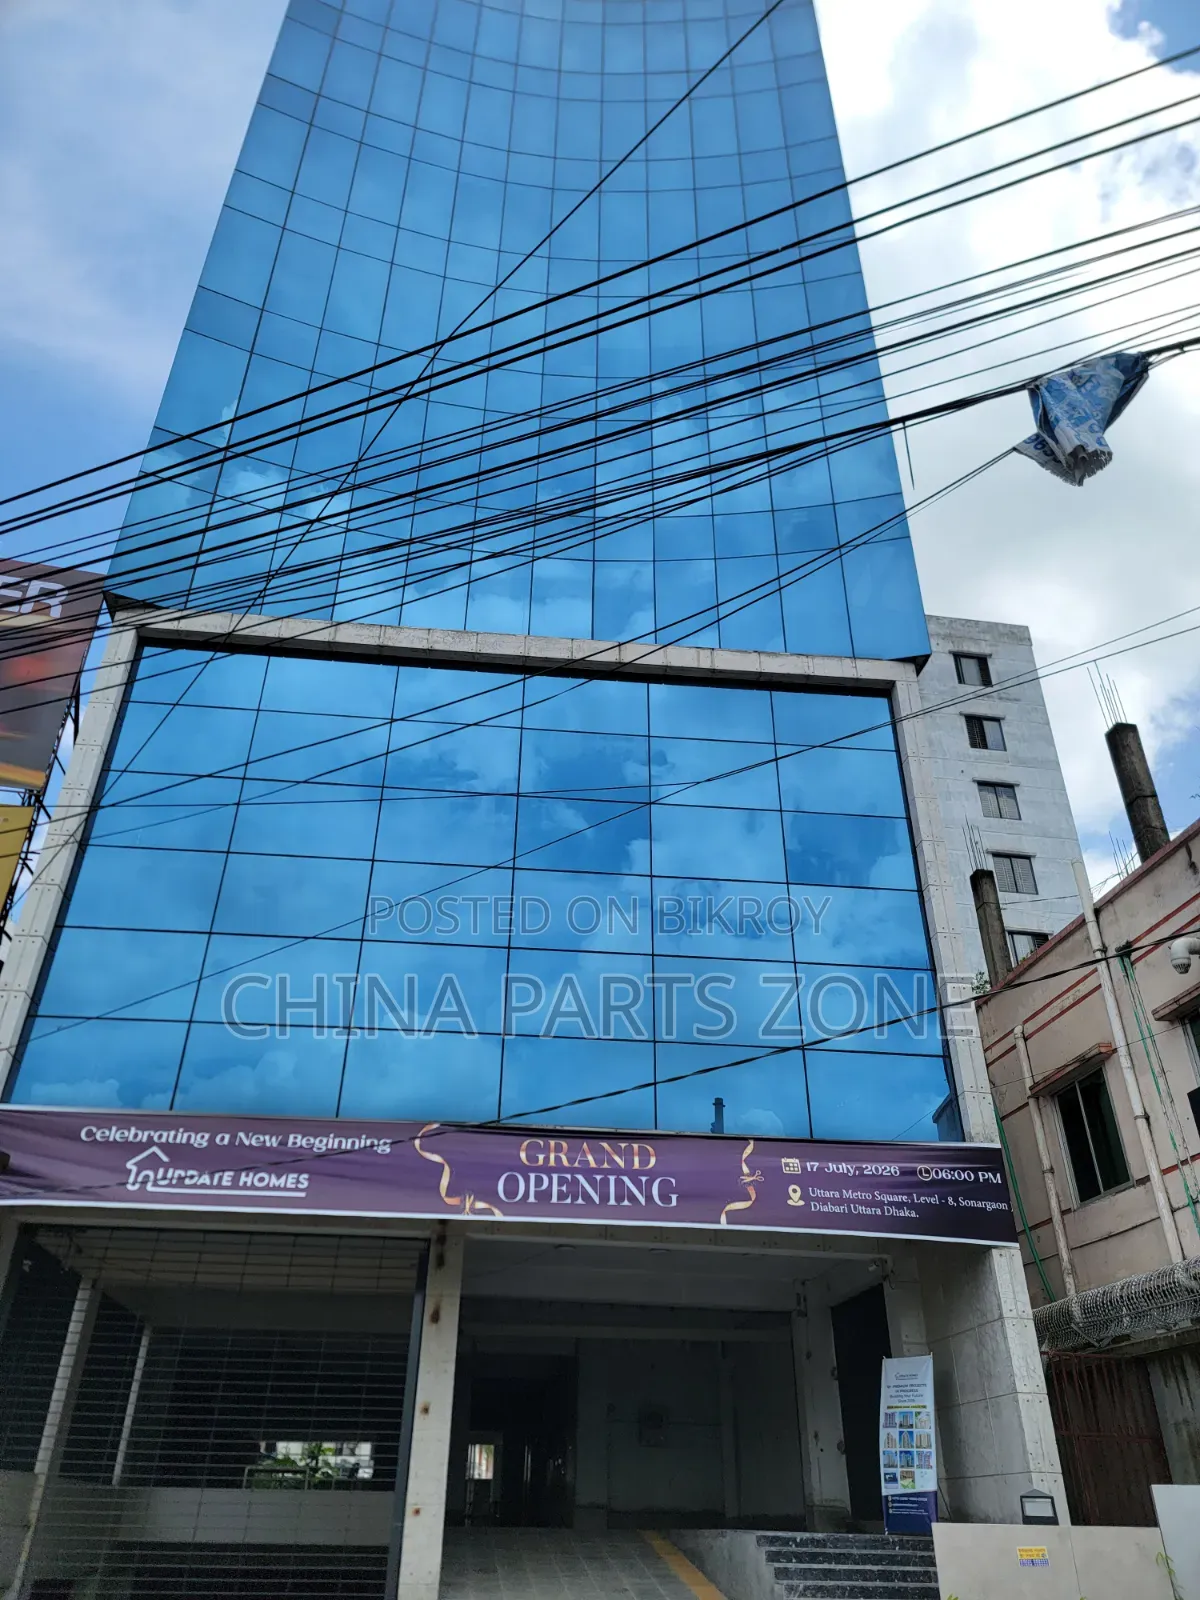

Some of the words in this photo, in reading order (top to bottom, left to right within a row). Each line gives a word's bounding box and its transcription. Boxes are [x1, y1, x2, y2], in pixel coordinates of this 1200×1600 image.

[80, 1125, 211, 1149] Celebrating
[215, 1132, 231, 1146] a
[235, 1131, 283, 1148] New
[287, 1133, 393, 1155] Beginning
[519, 1138, 656, 1170] GRAND
[156, 1167, 233, 1187] UPDATE
[239, 1171, 309, 1189] HOMES
[806, 1162, 819, 1172] 17
[824, 1162, 859, 1177] July,
[862, 1164, 900, 1177] 2026
[932, 1168, 975, 1182] 06:00
[978, 1171, 1002, 1184] PM
[497, 1171, 679, 1207] OPENING
[808, 1187, 840, 1198] Uttara
[842, 1189, 872, 1200] Metro
[874, 1191, 911, 1204] Square,
[913, 1193, 939, 1205] Level
[958, 1197, 1008, 1211] Sonargaon
[810, 1202, 848, 1213] Diabari
[850, 1204, 882, 1215] Uttara
[884, 1205, 919, 1218] Dhaka.
